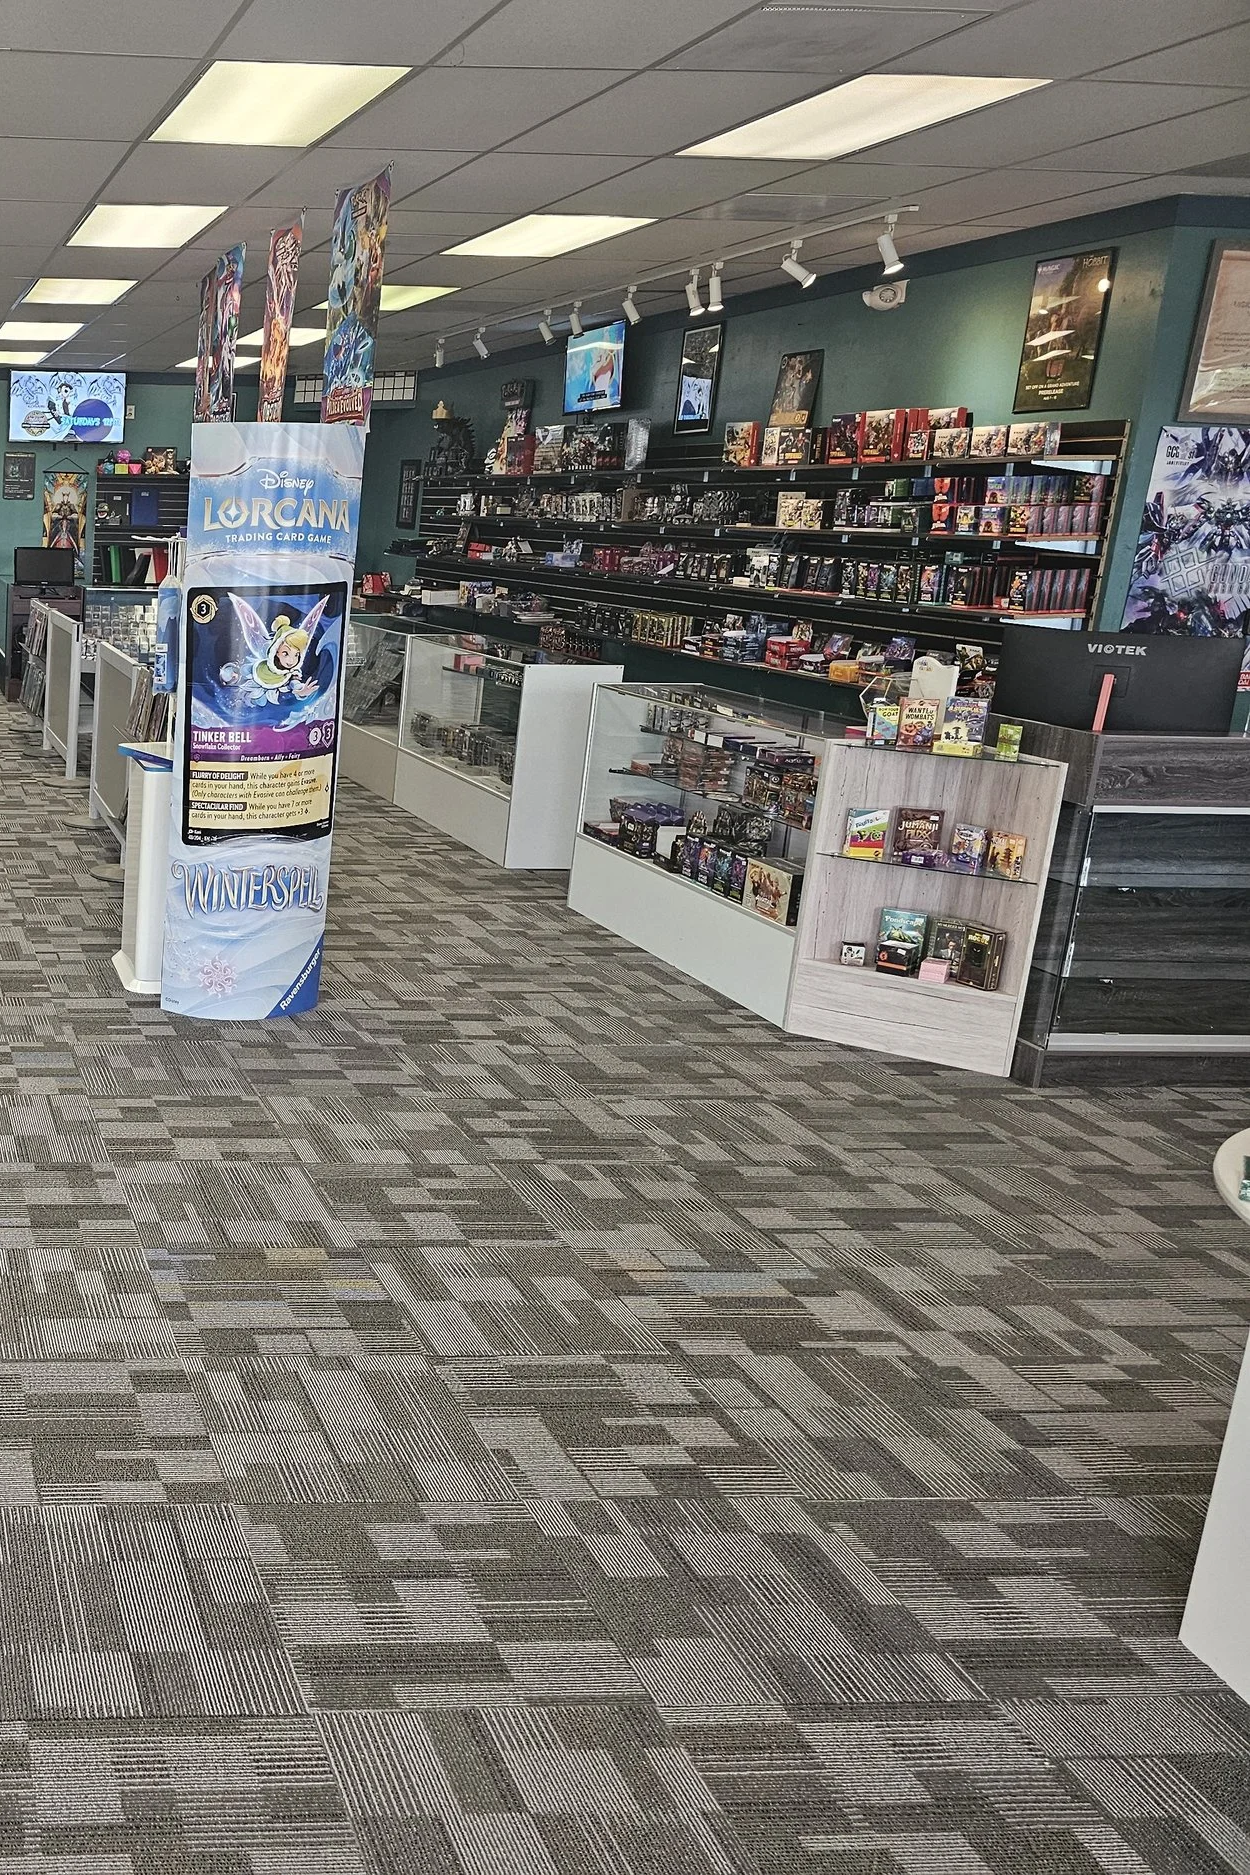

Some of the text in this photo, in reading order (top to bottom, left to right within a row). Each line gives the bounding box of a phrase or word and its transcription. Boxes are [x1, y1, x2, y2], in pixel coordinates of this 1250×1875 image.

[257, 468, 315, 496] Disney
[203, 496, 350, 534] LORCANA
[226, 532, 332, 544] TRADING CARD GAME
[200, 604, 207, 614] 3
[1087, 643, 1148, 656] VIOTEK
[905, 713, 935, 721] WOMBATS
[192, 730, 252, 743] TINKER BELL
[192, 772, 212, 780] FLURRY
[214, 783, 227, 791] your
[228, 782, 246, 791] hand,
[287, 779, 300, 787] gains
[192, 790, 206, 799] (Only
[207, 791, 238, 799] characters
[253, 790, 274, 799] Evasive
[286, 787, 309, 798] challenge
[191, 801, 229, 811] SPECTACULAR
[229, 803, 243, 811] FIND
[191, 811, 206, 819] cards
[213, 812, 227, 820] your
[228, 811, 245, 820] hand,
[258, 810, 284, 819] character
[286, 810, 297, 818] gets
[898, 821, 939, 832] JUMANJI
[171, 860, 325, 919] WINTERSPELL
[279, 948, 321, 1011] Ravensburger
